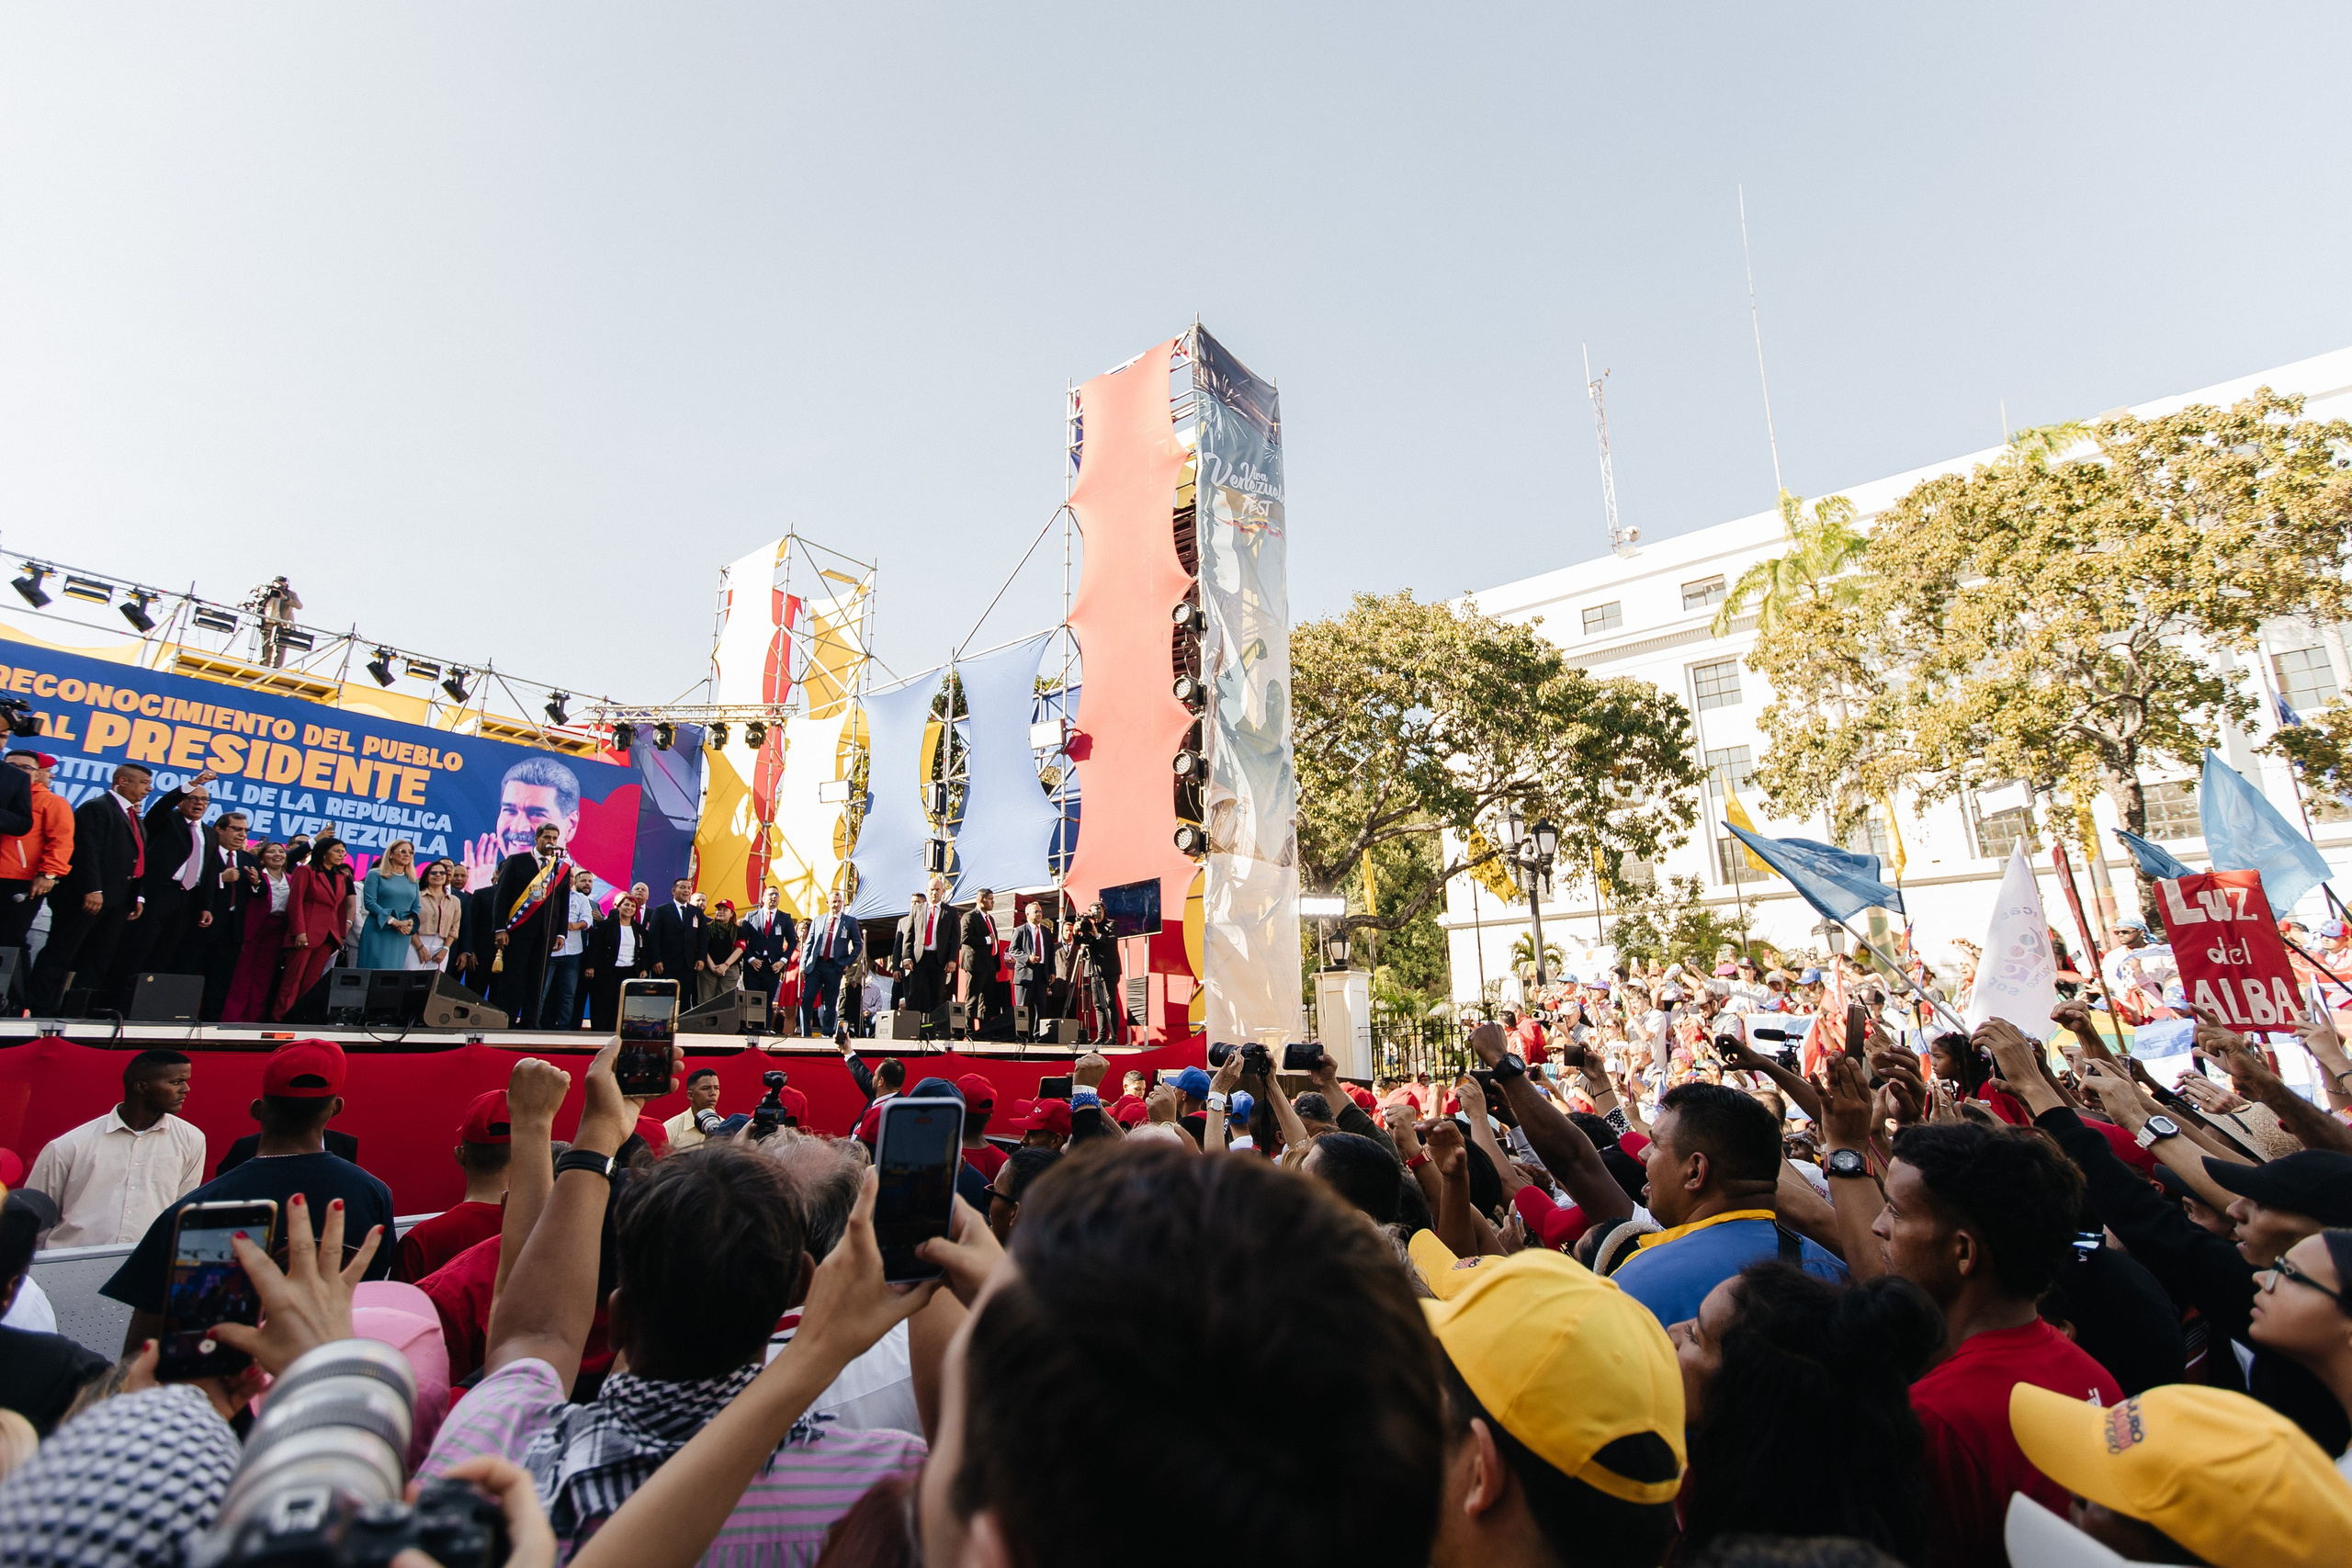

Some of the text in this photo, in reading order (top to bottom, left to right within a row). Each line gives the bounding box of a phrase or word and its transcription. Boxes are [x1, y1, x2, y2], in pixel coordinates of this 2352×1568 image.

[83, 711, 431, 806] PRESIDENTE
[302, 724, 355, 753] DEL
[362, 735, 463, 772] PUEBLO
[242, 784, 277, 807] DE
[279, 789, 316, 813] LA
[325, 796, 452, 833] REPÚBLICA
[2207, 936, 2252, 964] del
[2194, 976, 2305, 1026] ALBA
